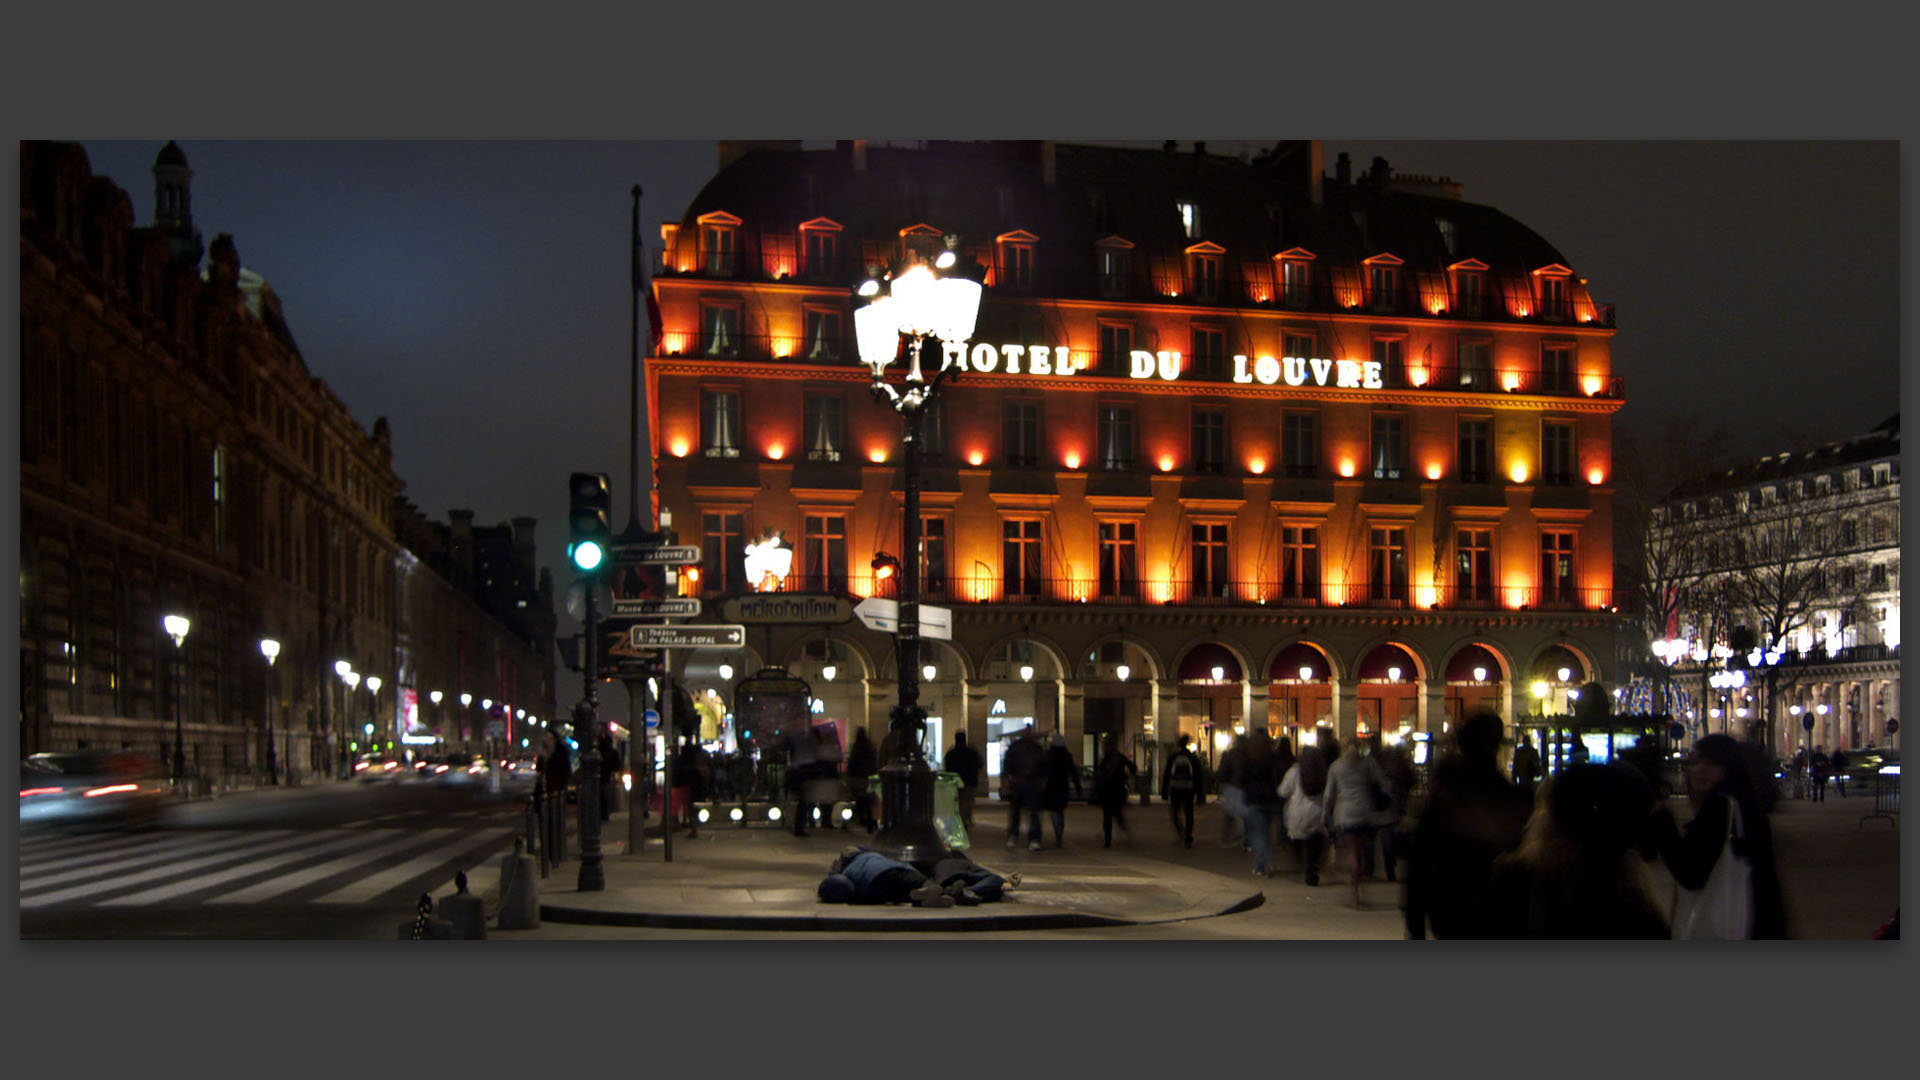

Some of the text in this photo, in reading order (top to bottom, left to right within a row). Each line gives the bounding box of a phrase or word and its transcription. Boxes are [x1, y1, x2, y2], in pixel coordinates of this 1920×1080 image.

[941, 342, 1383, 389] HOTEL DU LOUVRE
[655, 552, 684, 560] LOUVRE
[740, 600, 837, 618] METROPOLITAIN
